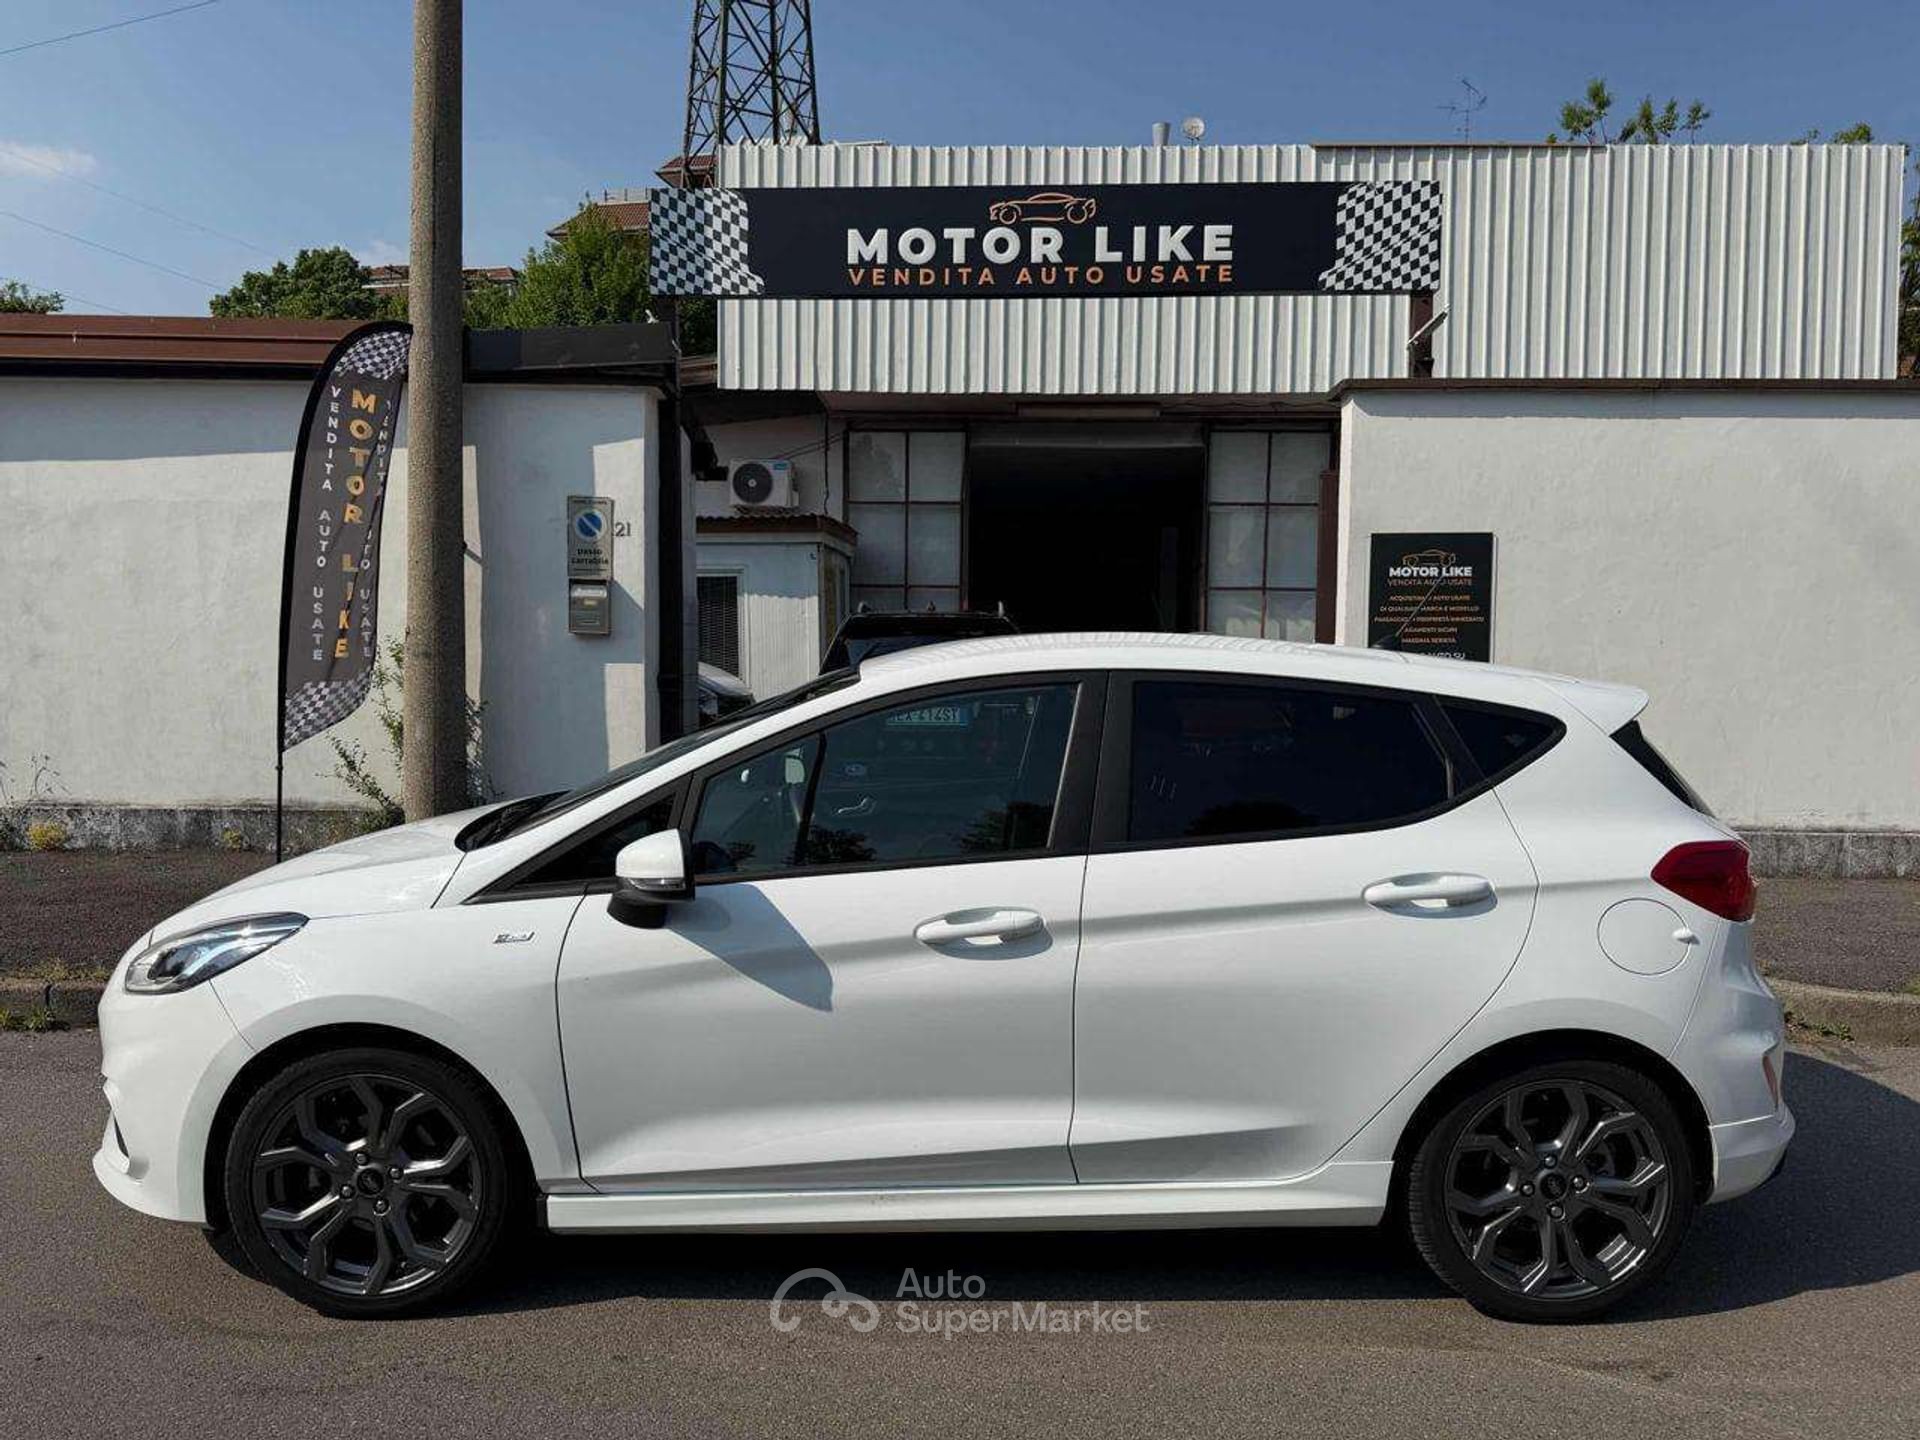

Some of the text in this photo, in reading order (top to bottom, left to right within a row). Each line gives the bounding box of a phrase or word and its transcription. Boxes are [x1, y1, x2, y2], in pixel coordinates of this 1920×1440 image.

[846, 224, 1234, 265] MOTOR LIKE
[848, 264, 1234, 287] VENDITA AUTO USATE
[311, 384, 343, 662] VENDITA AUTO USATE
[334, 388, 377, 659] MOTOR LIKE
[614, 521, 632, 537] 21
[1388, 565, 1473, 578] MOTOR LIKE
